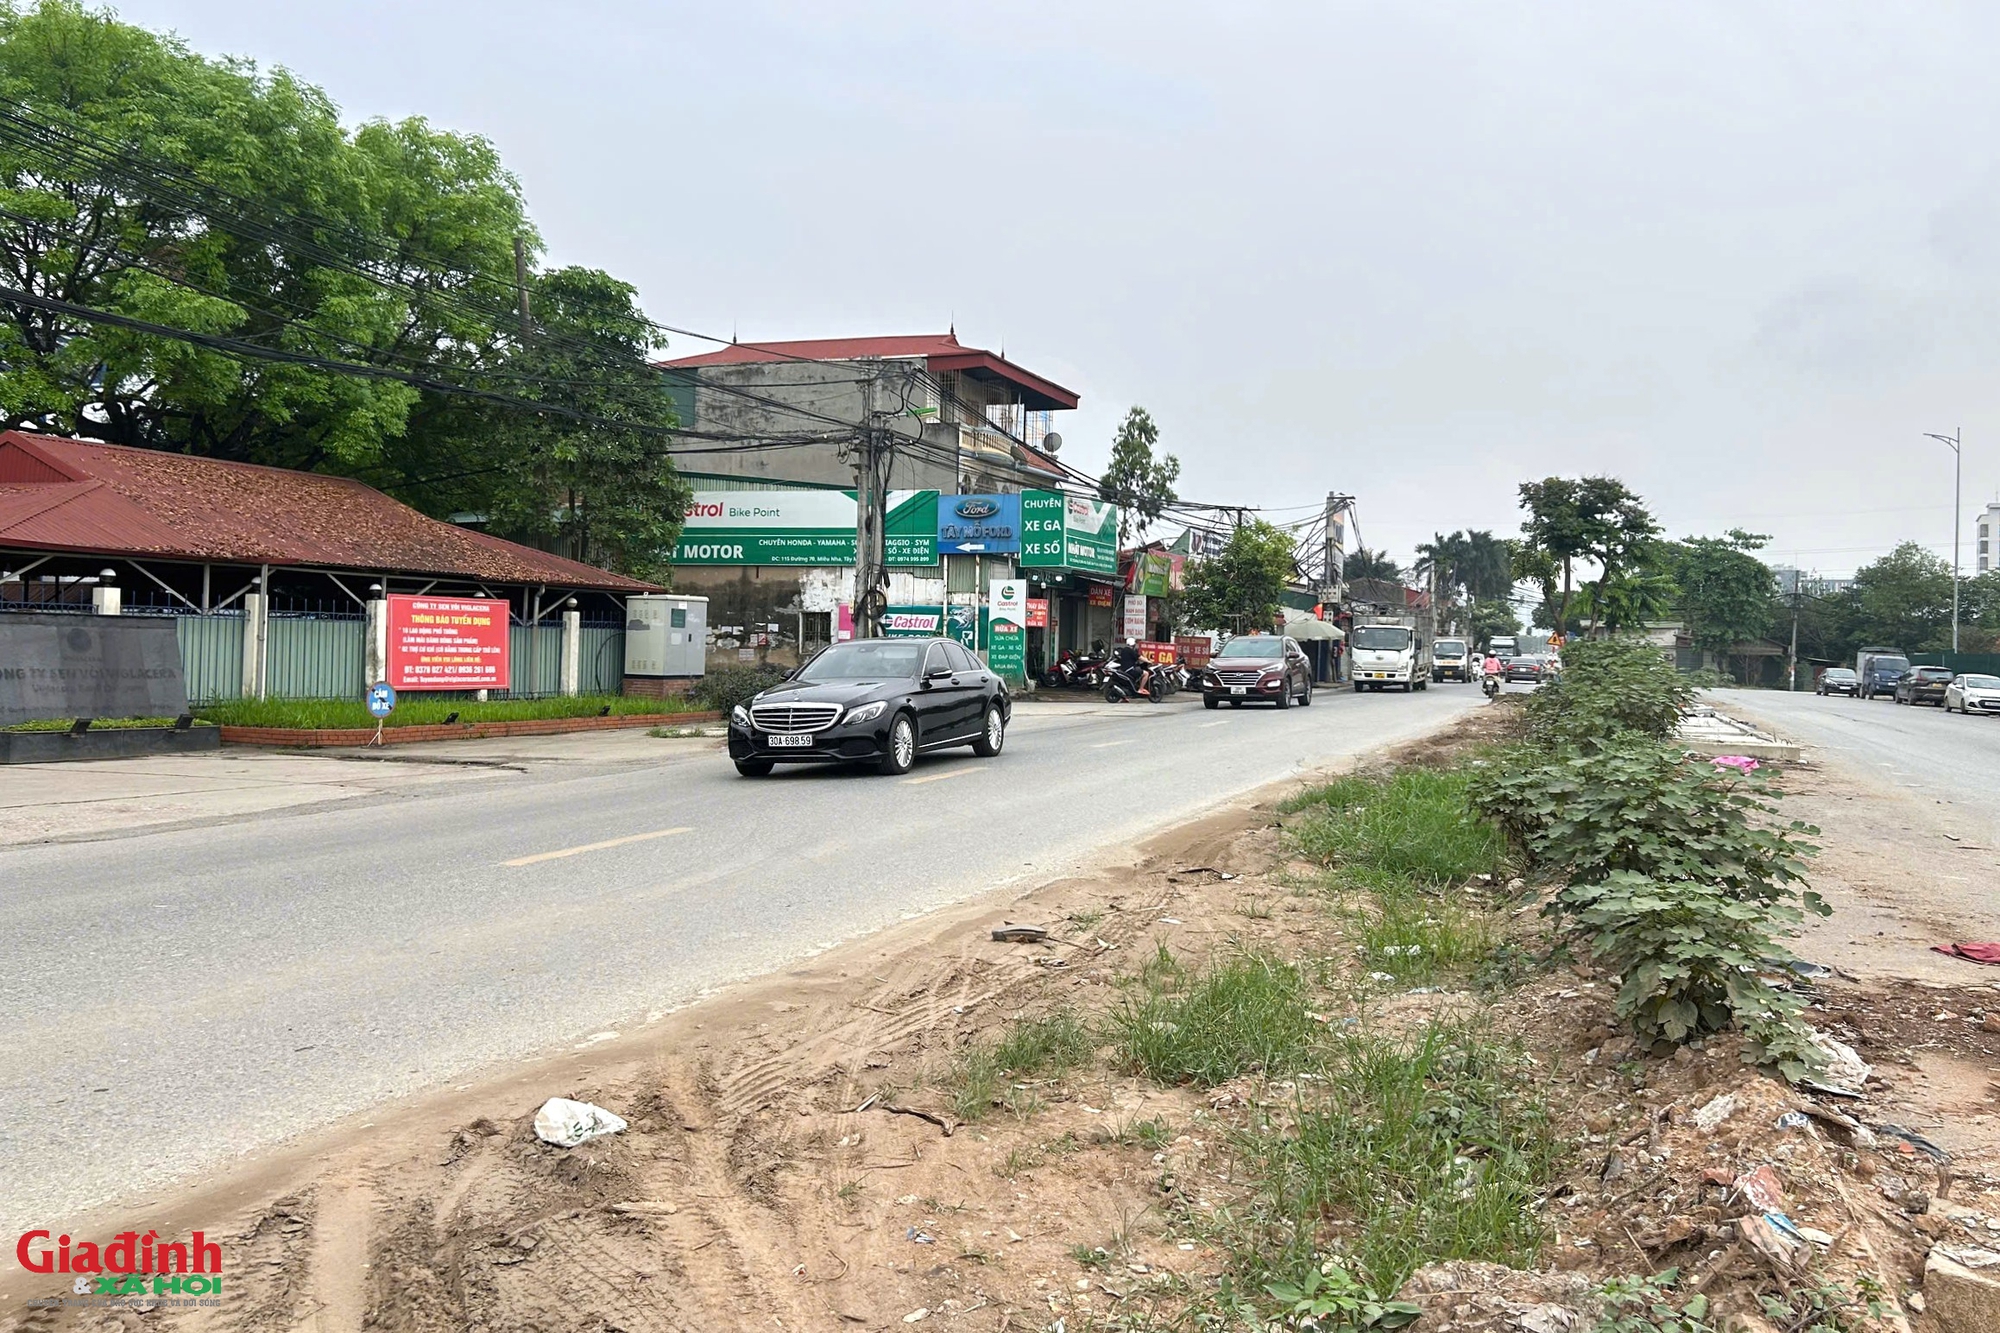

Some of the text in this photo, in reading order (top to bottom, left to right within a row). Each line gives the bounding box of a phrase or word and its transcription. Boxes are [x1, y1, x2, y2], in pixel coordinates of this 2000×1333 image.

[962, 502, 990, 514] Ford
[1024, 498, 1062, 508] CHUYÊN
[683, 502, 781, 517] strol Bike Point
[1025, 520, 1062, 531] XE GA
[983, 525, 1013, 539] FORD
[758, 538, 786, 546] CHUYÊN
[1025, 540, 1061, 554] XE SỐ
[683, 545, 744, 559] MOTOR
[888, 546, 898, 555] SỐ
[411, 614, 435, 624] THÔNG
[435, 615, 450, 624] BÁO
[894, 616, 935, 629] Castrol
[1158, 652, 1174, 664] GA
